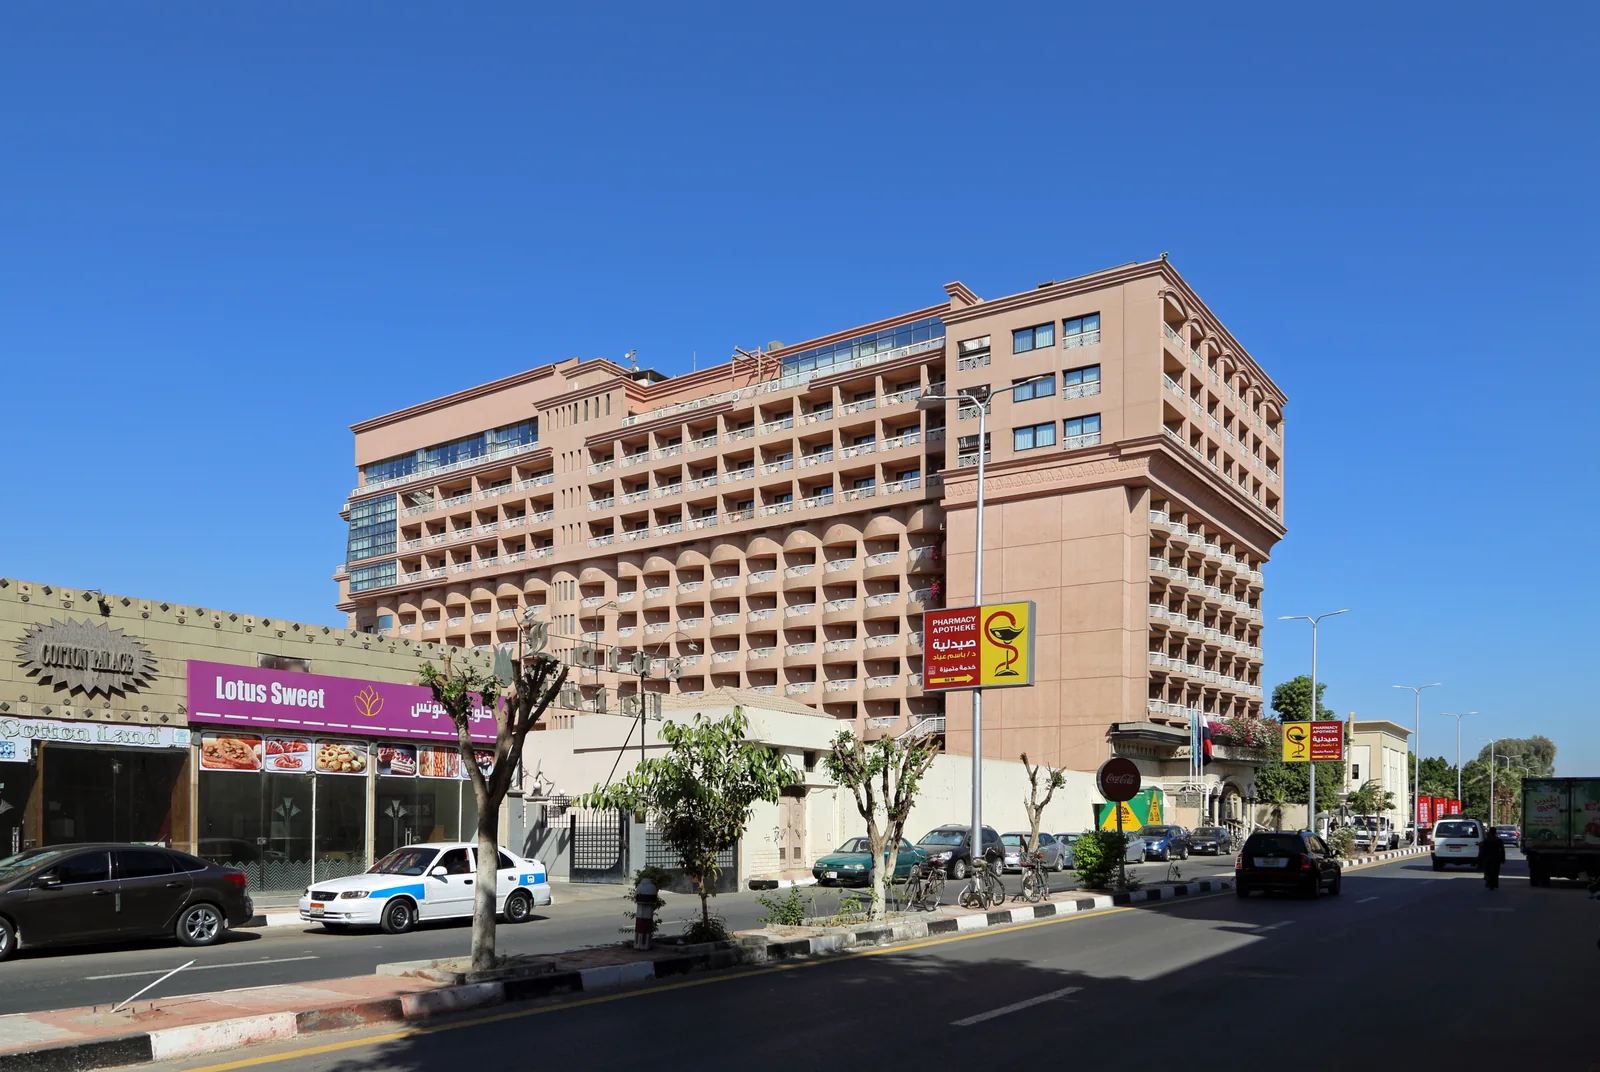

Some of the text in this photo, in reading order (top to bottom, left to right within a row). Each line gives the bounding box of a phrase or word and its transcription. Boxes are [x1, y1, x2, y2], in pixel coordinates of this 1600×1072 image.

[932, 616, 976, 626] PHARMACY
[932, 624, 976, 634] APOTHEKE
[932, 638, 976, 652] صيدلية
[41, 643, 134, 673] COTTON PALACE
[215, 676, 325, 709] Lotus Sweet
[0, 718, 161, 745] Cotton Land
